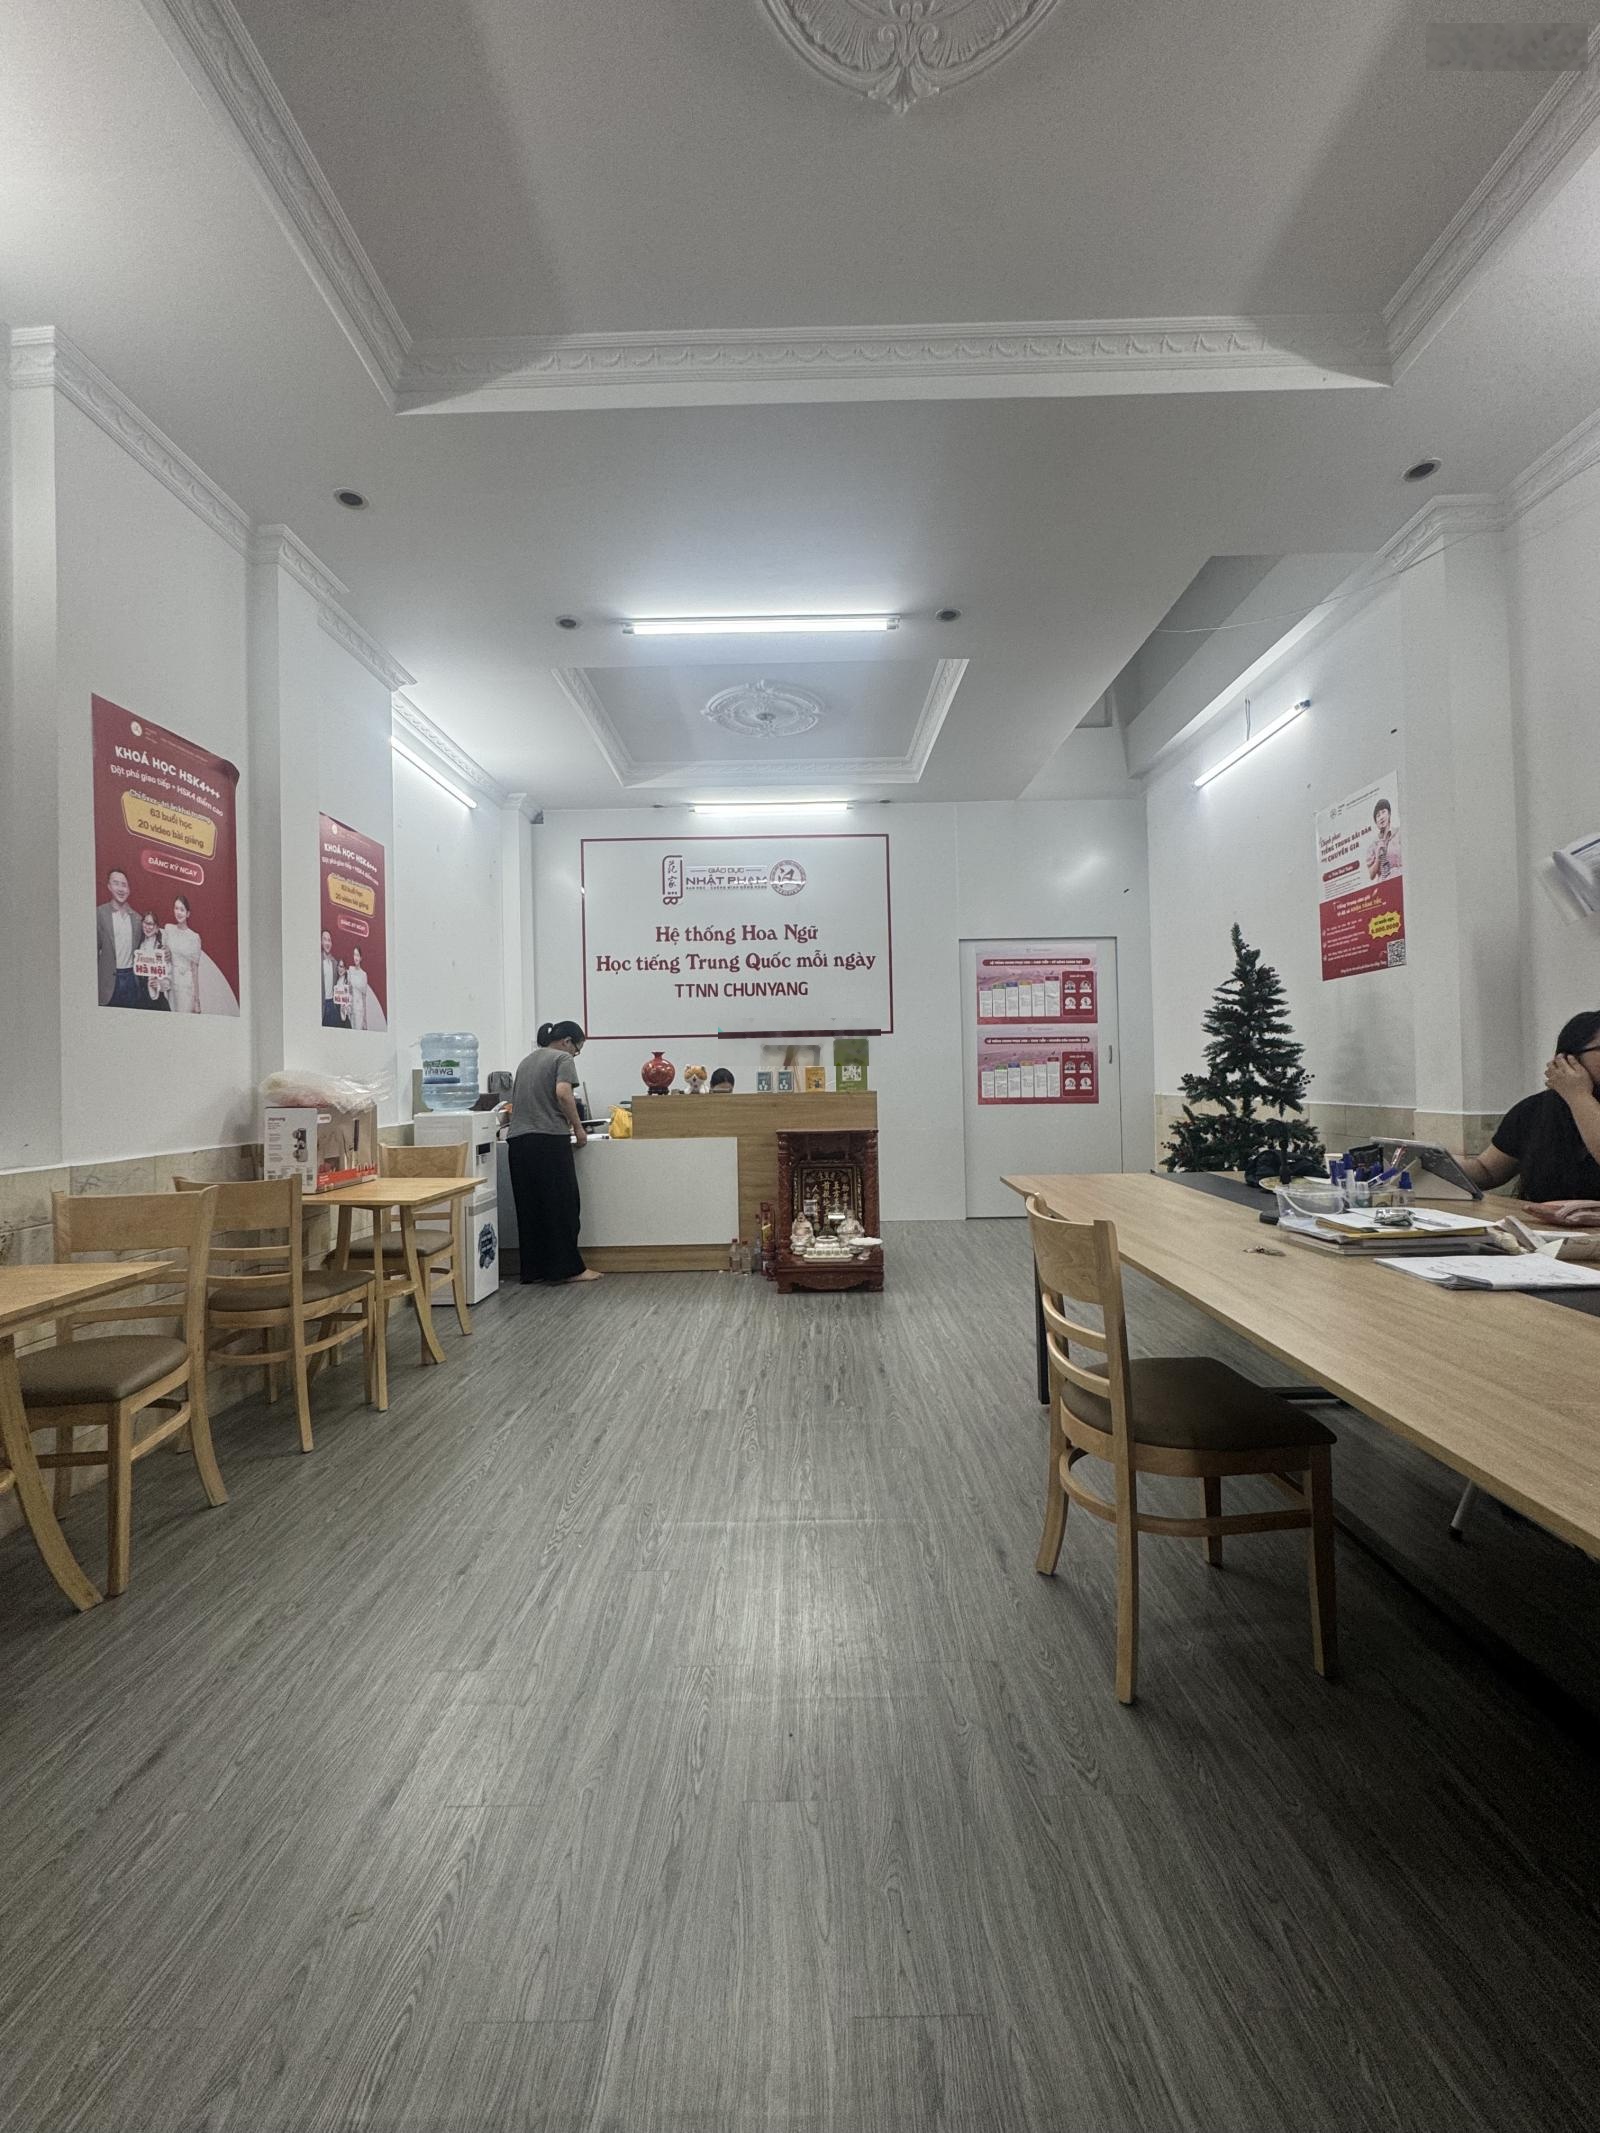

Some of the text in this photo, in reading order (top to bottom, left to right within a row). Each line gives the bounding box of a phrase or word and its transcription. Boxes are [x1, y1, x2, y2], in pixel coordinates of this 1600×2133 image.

[115, 746, 149, 766] KHOÁ
[152, 757, 176, 776] HỌC
[110, 764, 125, 776] Đột
[125, 768, 140, 779] phá
[141, 772, 156, 784] giao
[157, 776, 171, 789] tiếp
[177, 785, 196, 801] HSK4
[196, 794, 212, 810] điểm
[212, 805, 224, 817] cao
[161, 811, 178, 826] buổi
[179, 817, 192, 830] học
[137, 819, 204, 849] 20 video bài giảng
[148, 857, 198, 877] ĐĂNG KÝ NGAY
[708, 866, 745, 875] GIÁO DỤC
[686, 874, 725, 887] NHẬT
[655, 924, 818, 945] Hệ thống Hoa Ngữ
[135, 964, 166, 977] Hà Nội
[596, 949, 876, 974] Học tiếng Trung Quốc mỗi ngày
[674, 981, 808, 998] TTNN CHUNYANG
